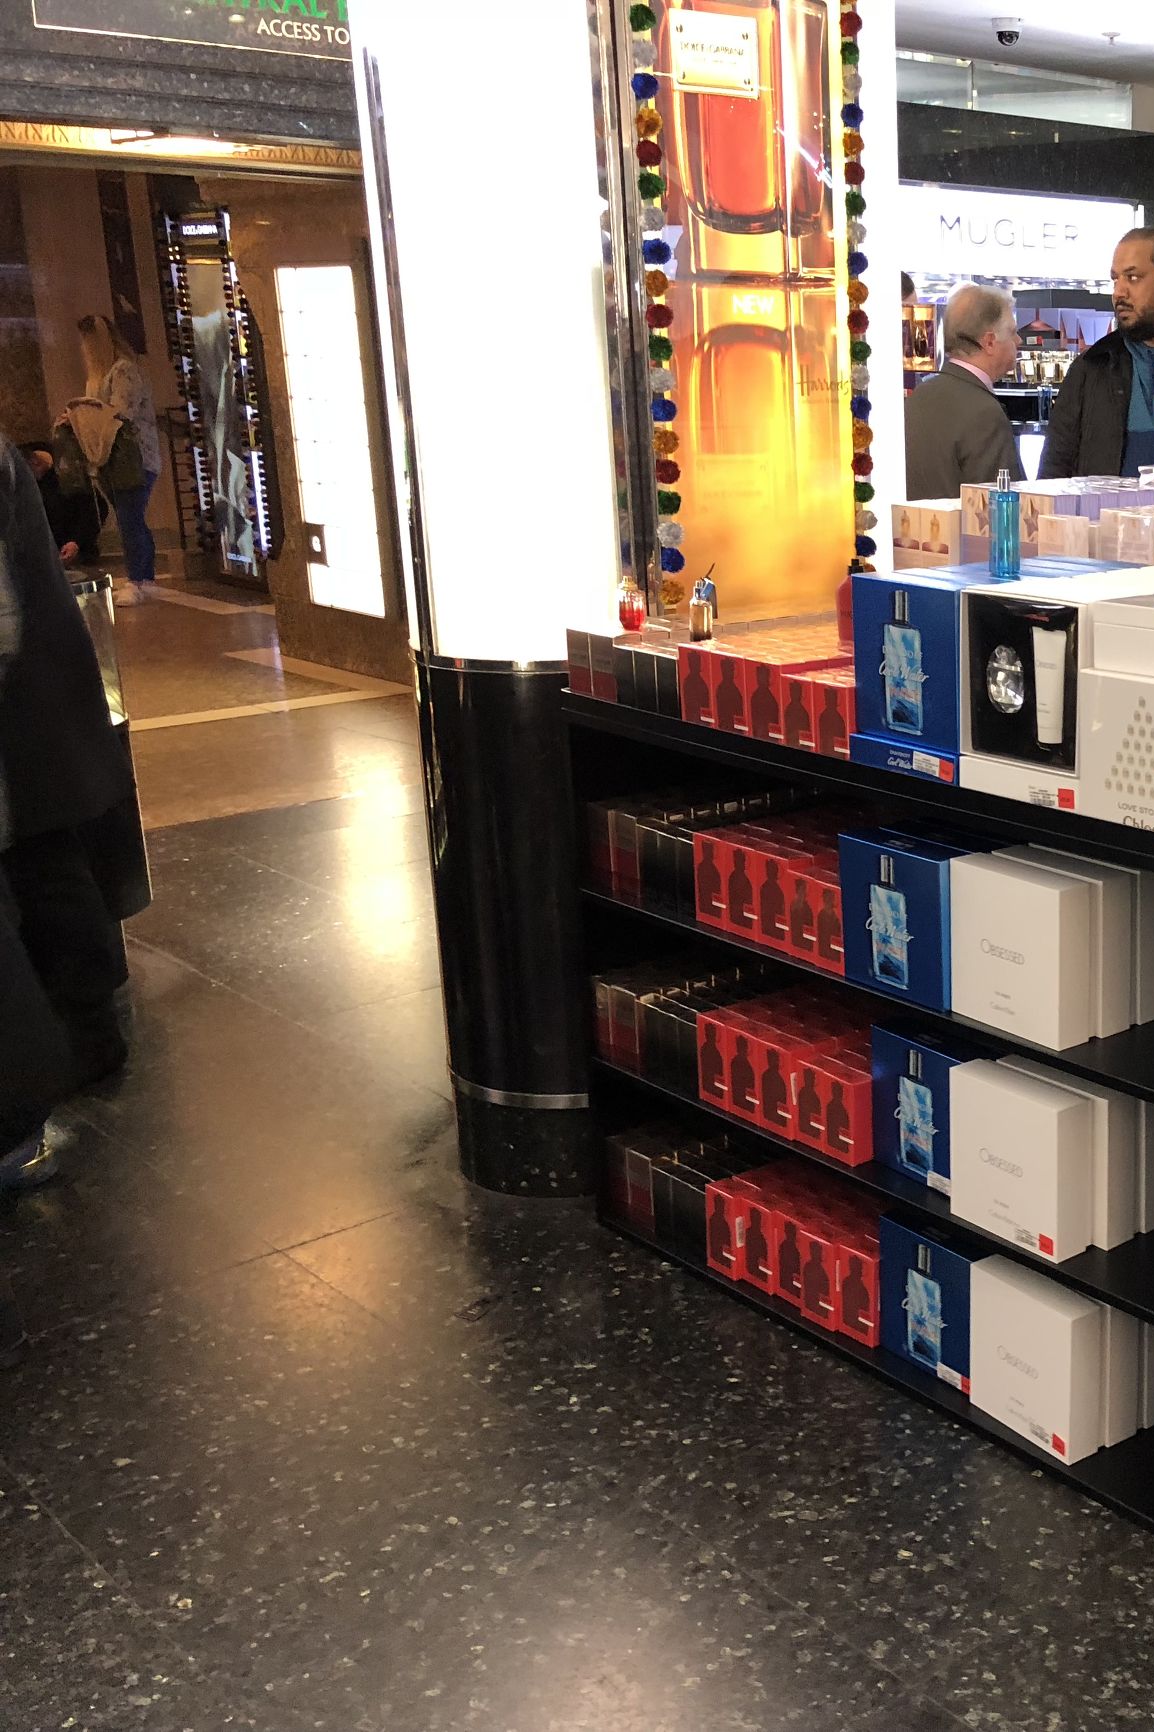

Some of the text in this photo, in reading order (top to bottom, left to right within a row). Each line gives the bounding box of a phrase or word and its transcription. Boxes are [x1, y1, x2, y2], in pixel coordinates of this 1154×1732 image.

[257, 17, 350, 44] ACCESS TO
[939, 214, 1079, 249] MUGLER
[732, 294, 775, 315] NEW
[1117, 802, 1137, 812] LOVE
